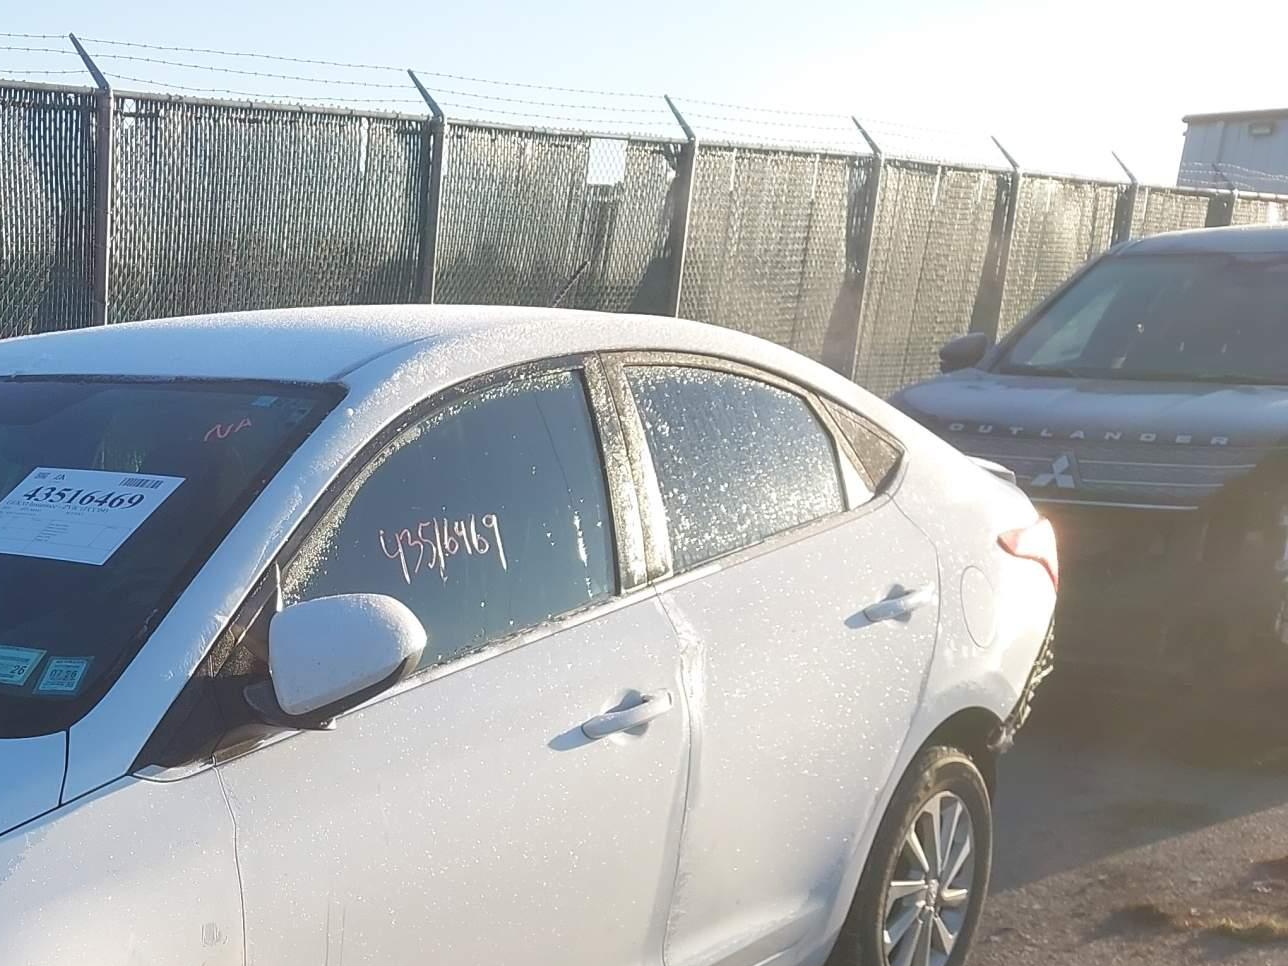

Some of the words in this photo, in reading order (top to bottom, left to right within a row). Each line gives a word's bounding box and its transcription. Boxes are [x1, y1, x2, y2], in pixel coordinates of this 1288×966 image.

[949, 423, 1228, 446] OUTLANDER
[23, 485, 145, 509] 43516469
[379, 512, 508, 585] 43516469
